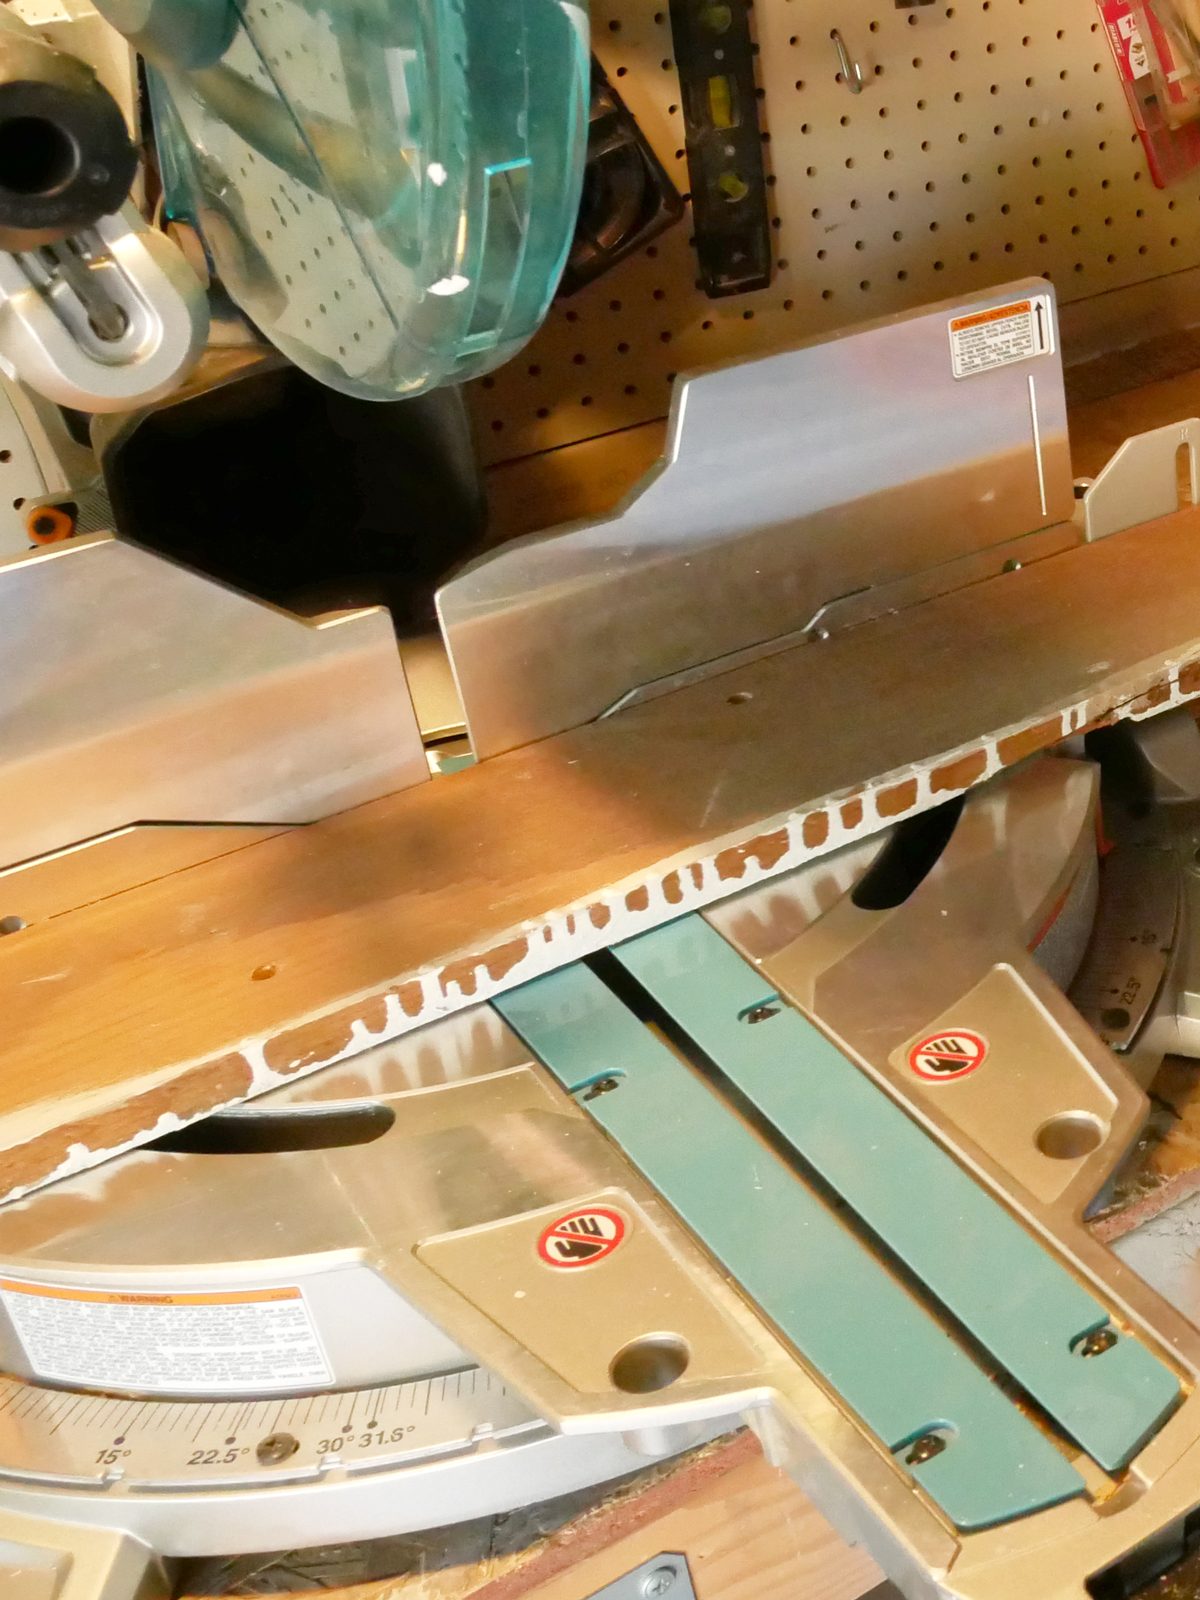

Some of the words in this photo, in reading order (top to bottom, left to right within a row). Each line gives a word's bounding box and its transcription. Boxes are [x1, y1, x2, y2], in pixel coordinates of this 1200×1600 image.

[119, 1295, 173, 1304] WARNING
[95, 1449, 132, 1465] 15°
[187, 1448, 250, 1466] 22.5°
[316, 1436, 354, 1455] 30°
[358, 1425, 416, 1450] 31.6°
